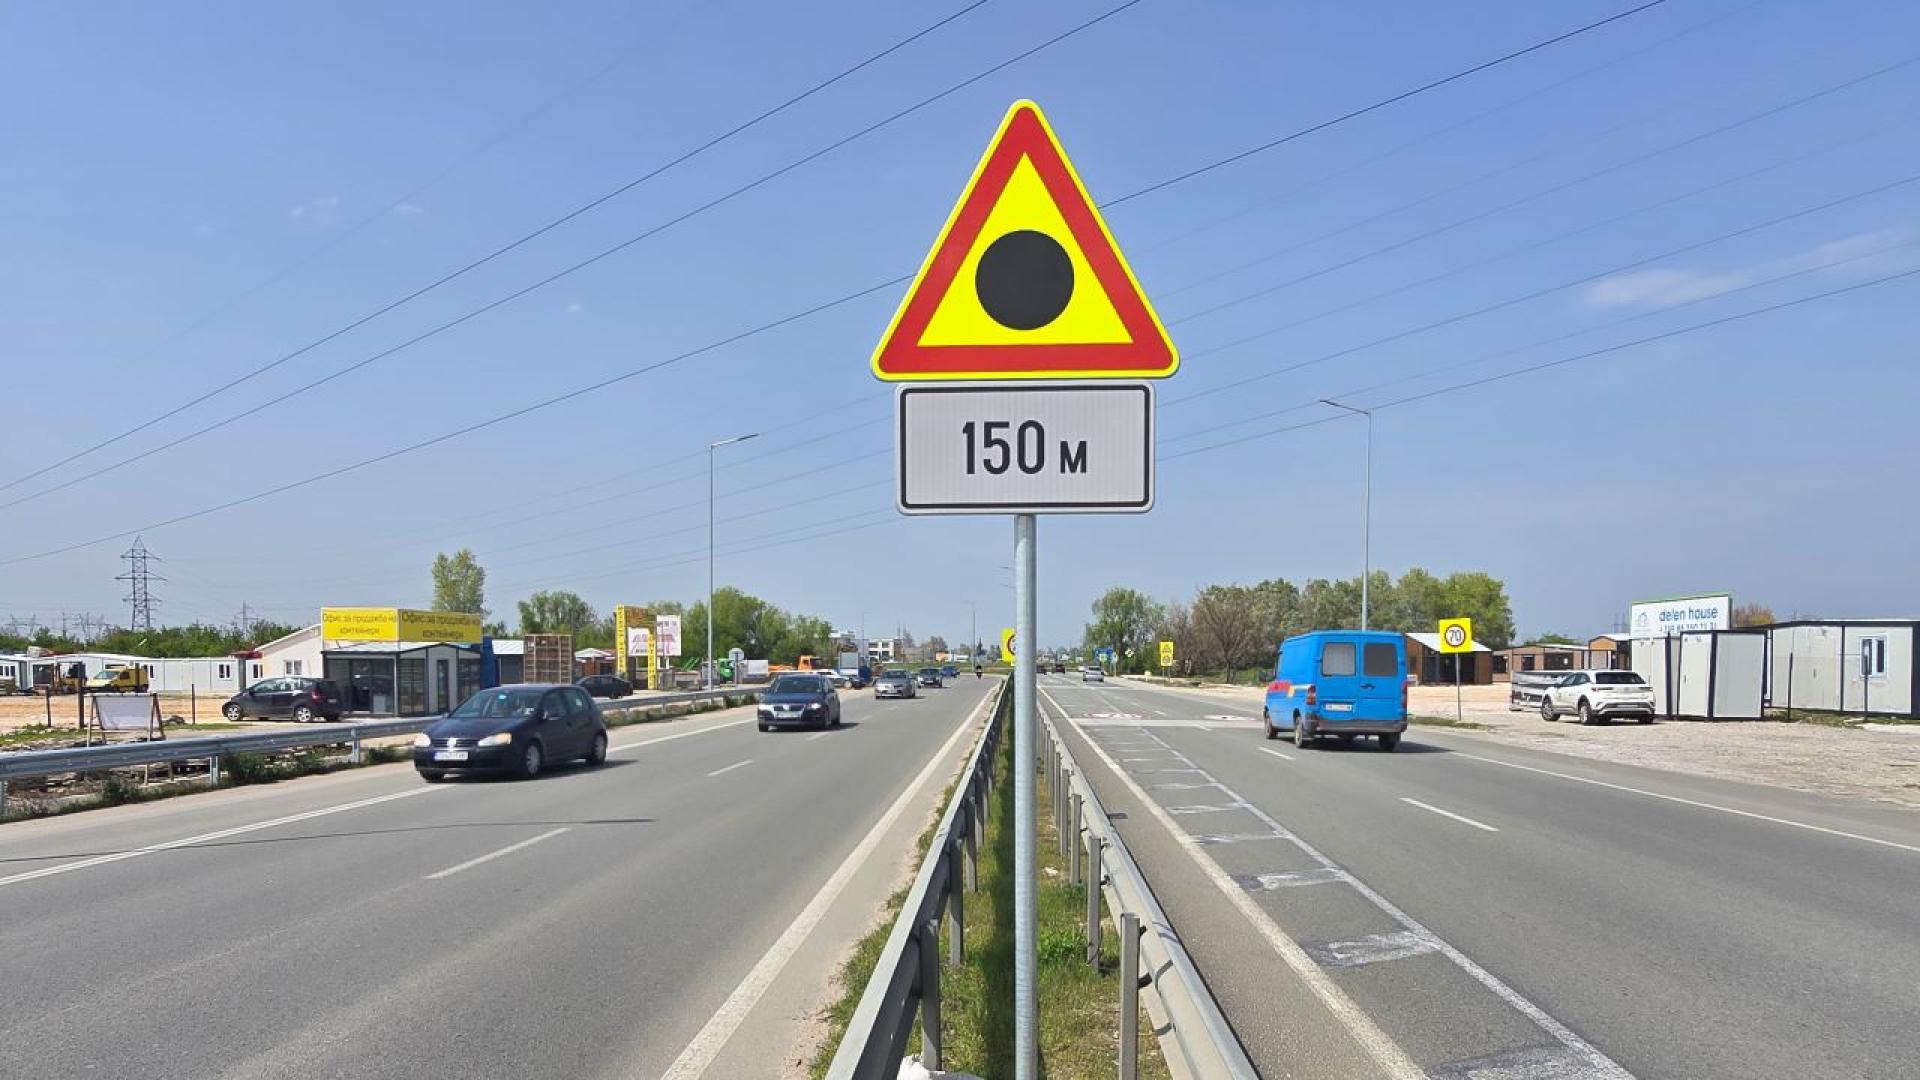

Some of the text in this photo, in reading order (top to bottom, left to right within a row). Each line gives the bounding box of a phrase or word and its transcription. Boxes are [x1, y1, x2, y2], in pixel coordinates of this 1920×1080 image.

[962, 419, 1045, 475] 150
[323, 613, 342, 624] Офис
[402, 611, 424, 624] Офис
[1659, 606, 1719, 622] delen house
[1449, 629, 1462, 642] 70
